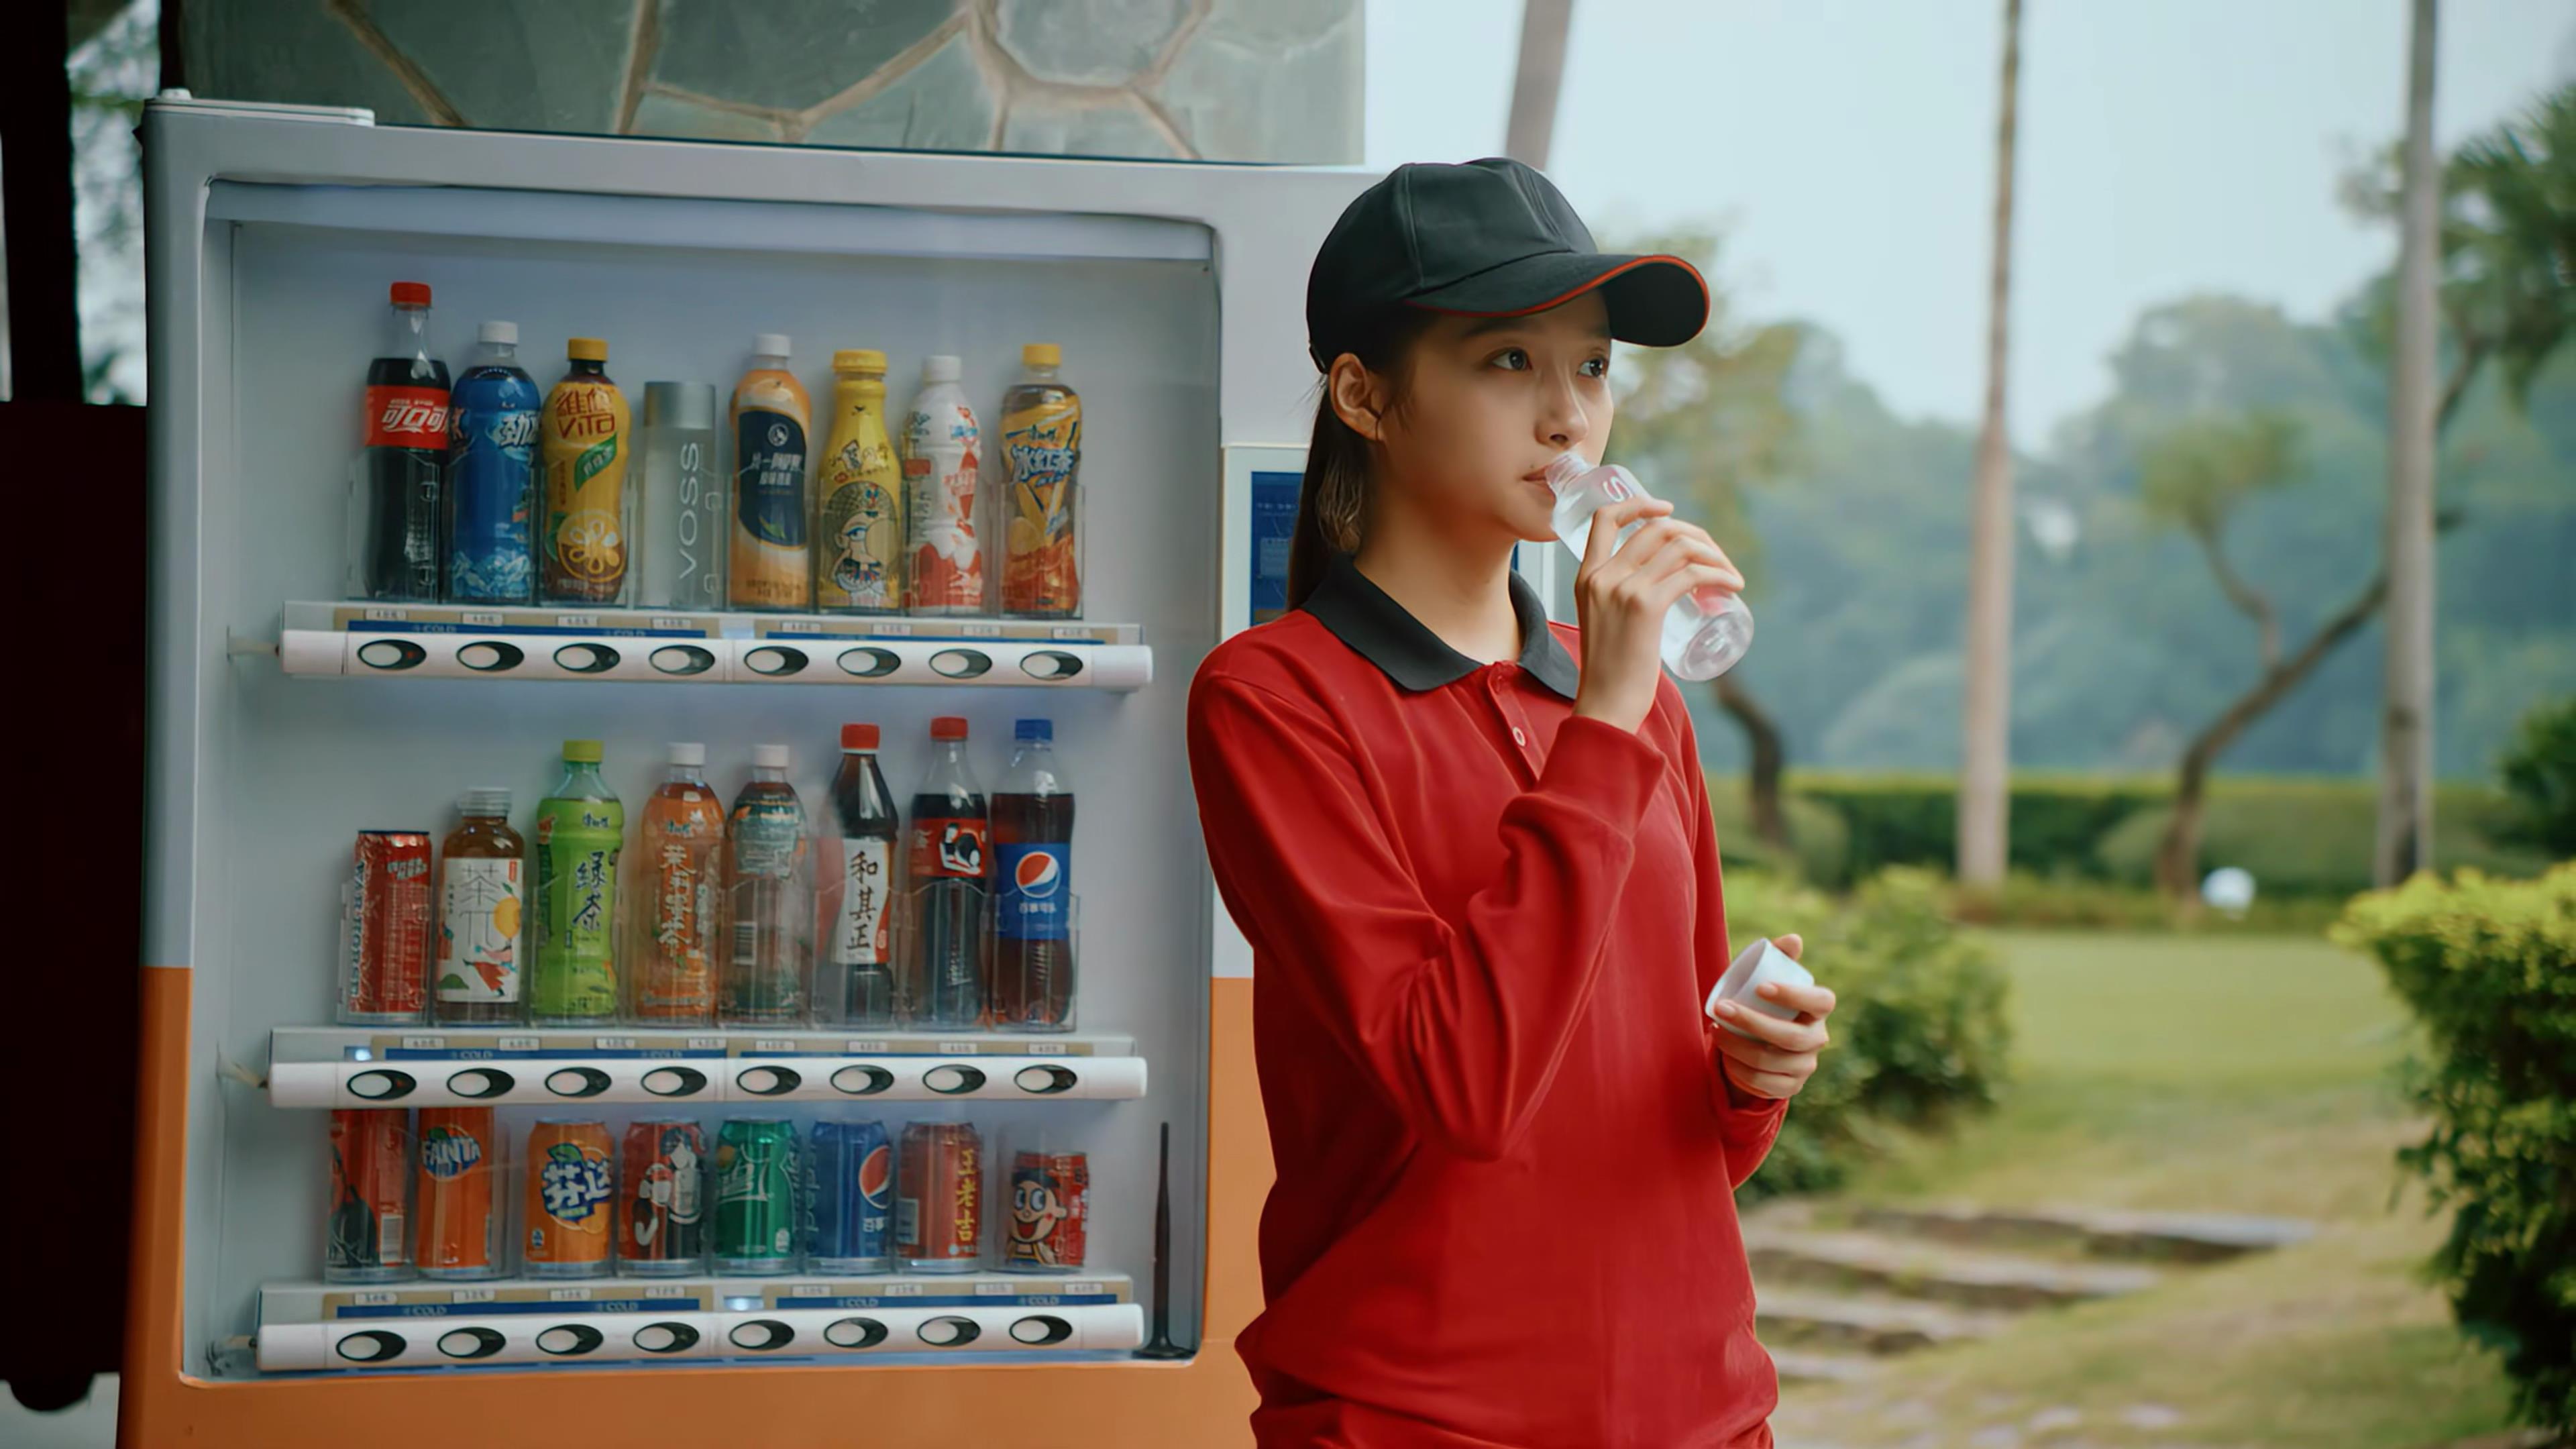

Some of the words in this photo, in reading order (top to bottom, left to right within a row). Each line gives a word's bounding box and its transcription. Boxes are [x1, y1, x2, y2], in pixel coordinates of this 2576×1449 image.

[680, 443, 699, 579] VOSS
[846, 851, 878, 951] 和其正
[543, 1159, 612, 1210] 芬达
[955, 1148, 977, 1242] 王老吉
